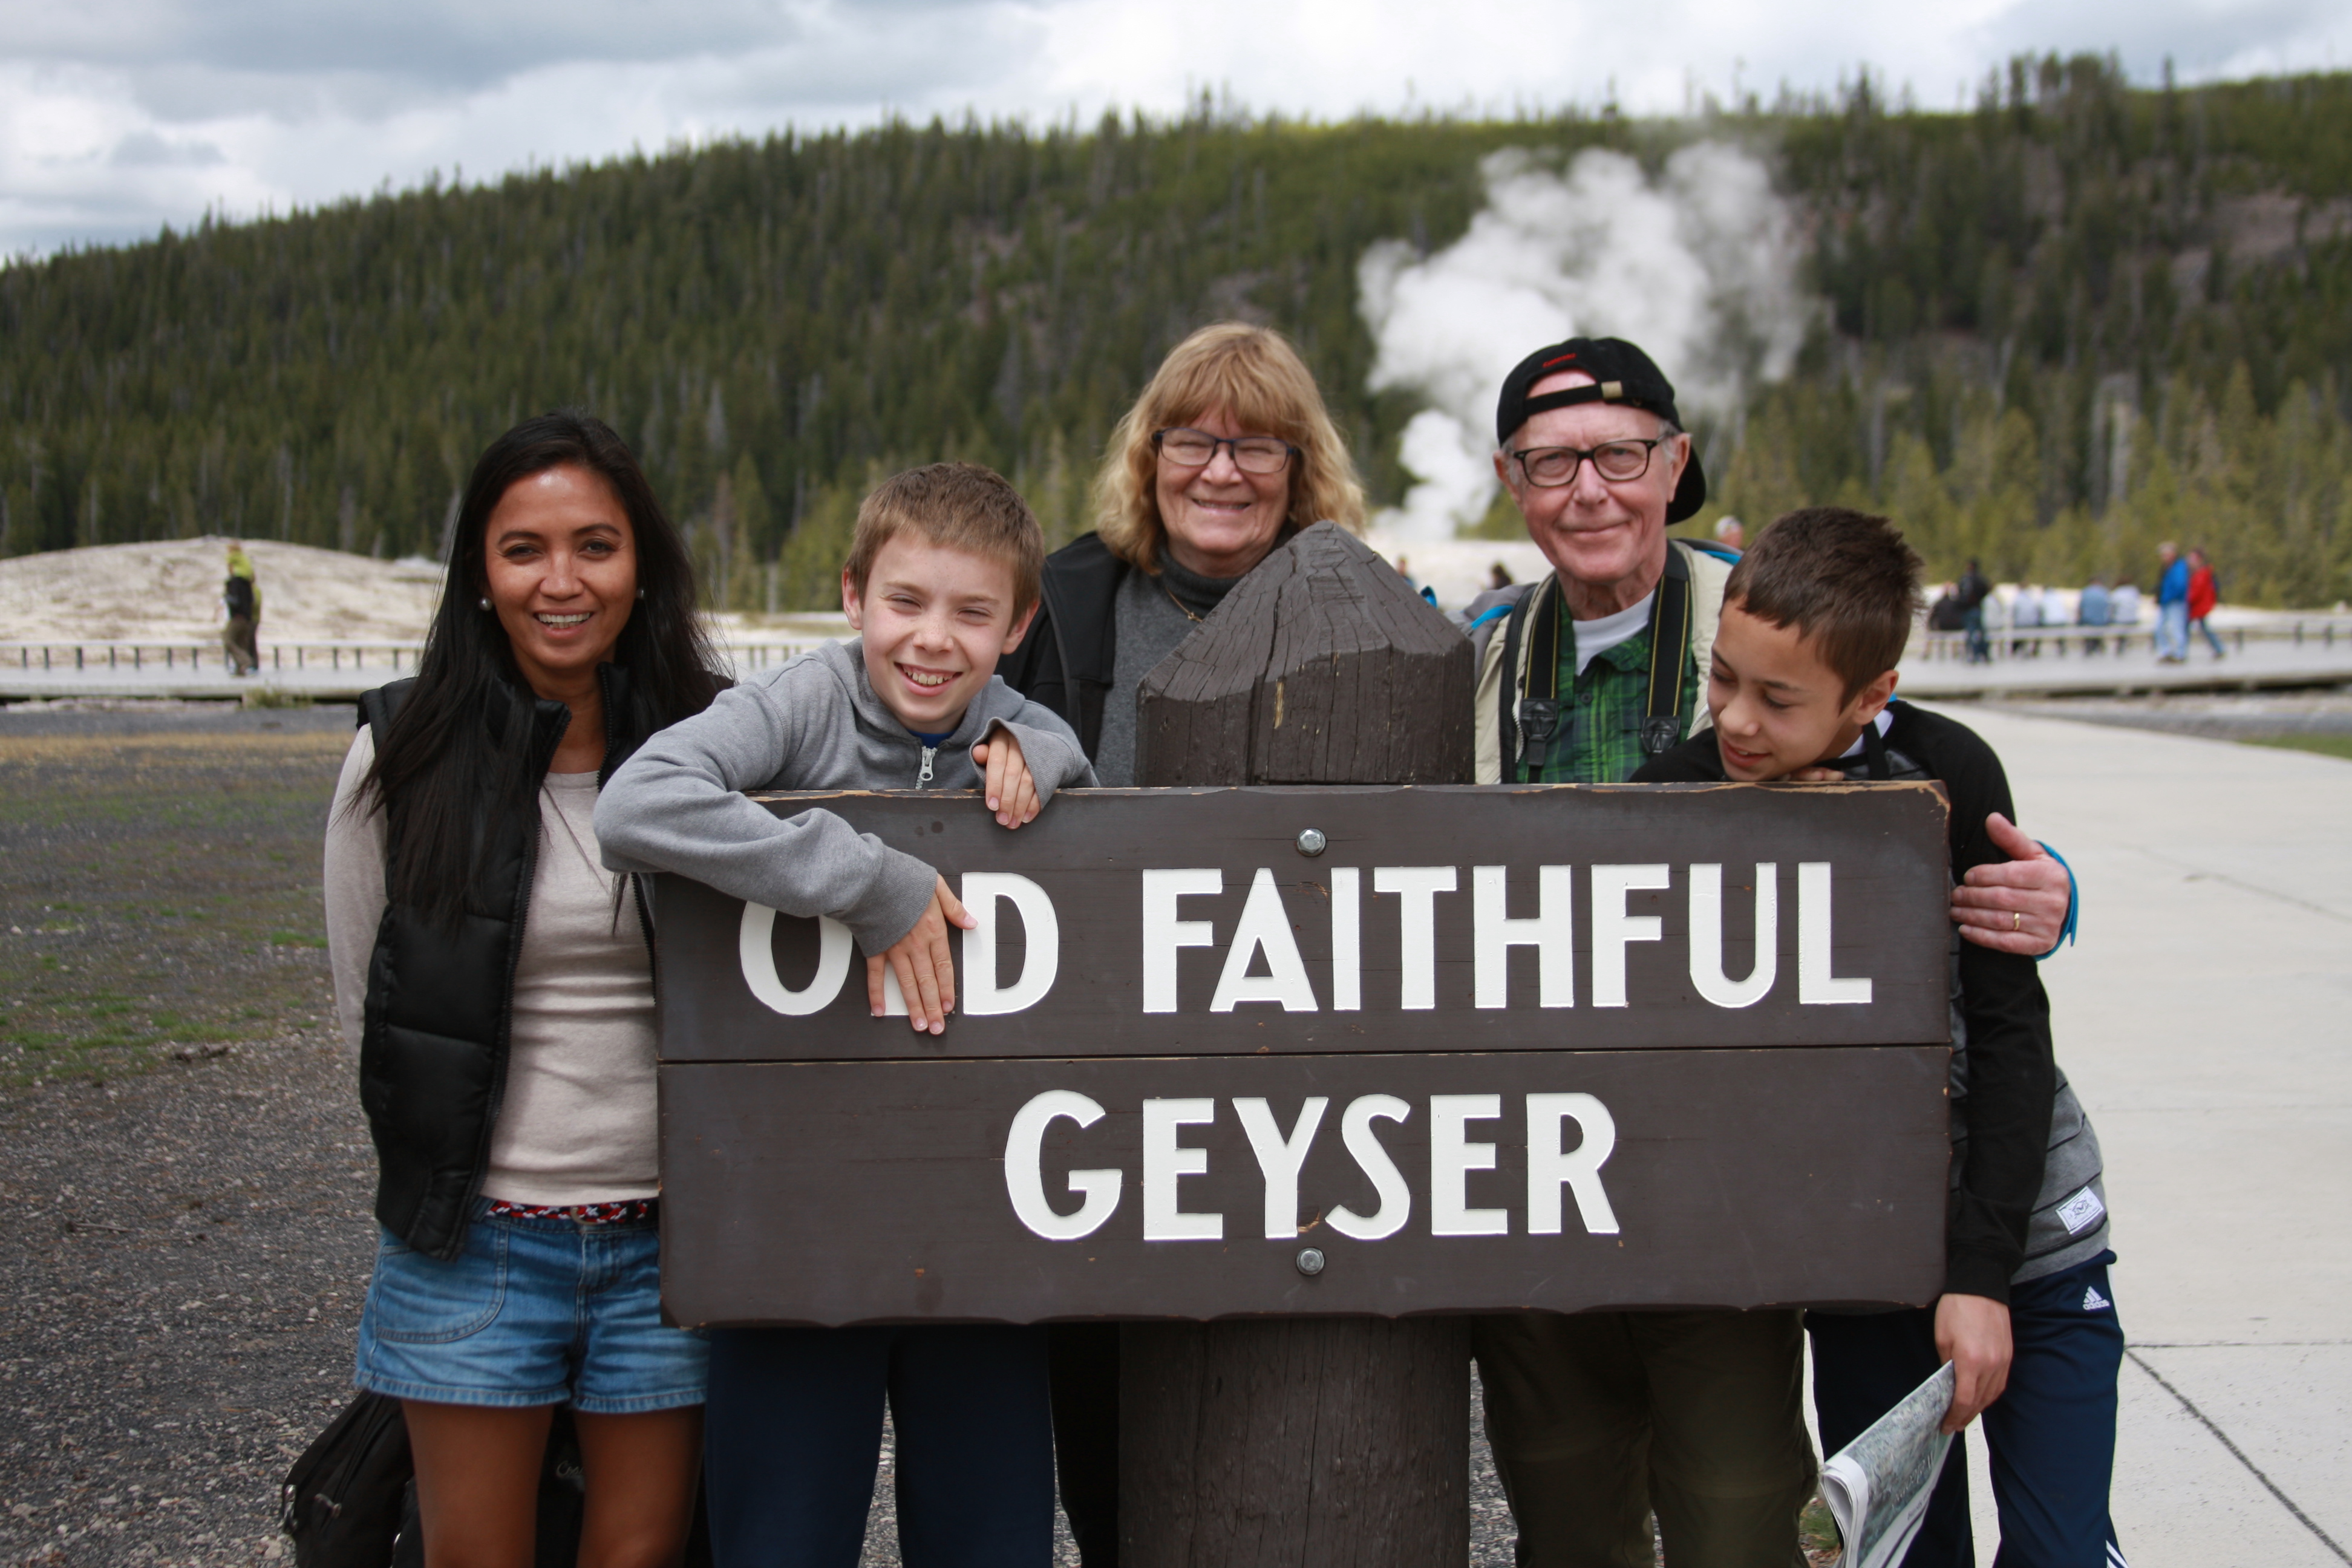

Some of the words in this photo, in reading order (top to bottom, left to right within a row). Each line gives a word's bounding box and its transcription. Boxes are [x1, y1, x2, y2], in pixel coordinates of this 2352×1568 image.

[739, 872, 1059, 1016] OD
[1142, 861, 1872, 1013] FAITHFUL
[1004, 1089, 1619, 1241] GEYSER
